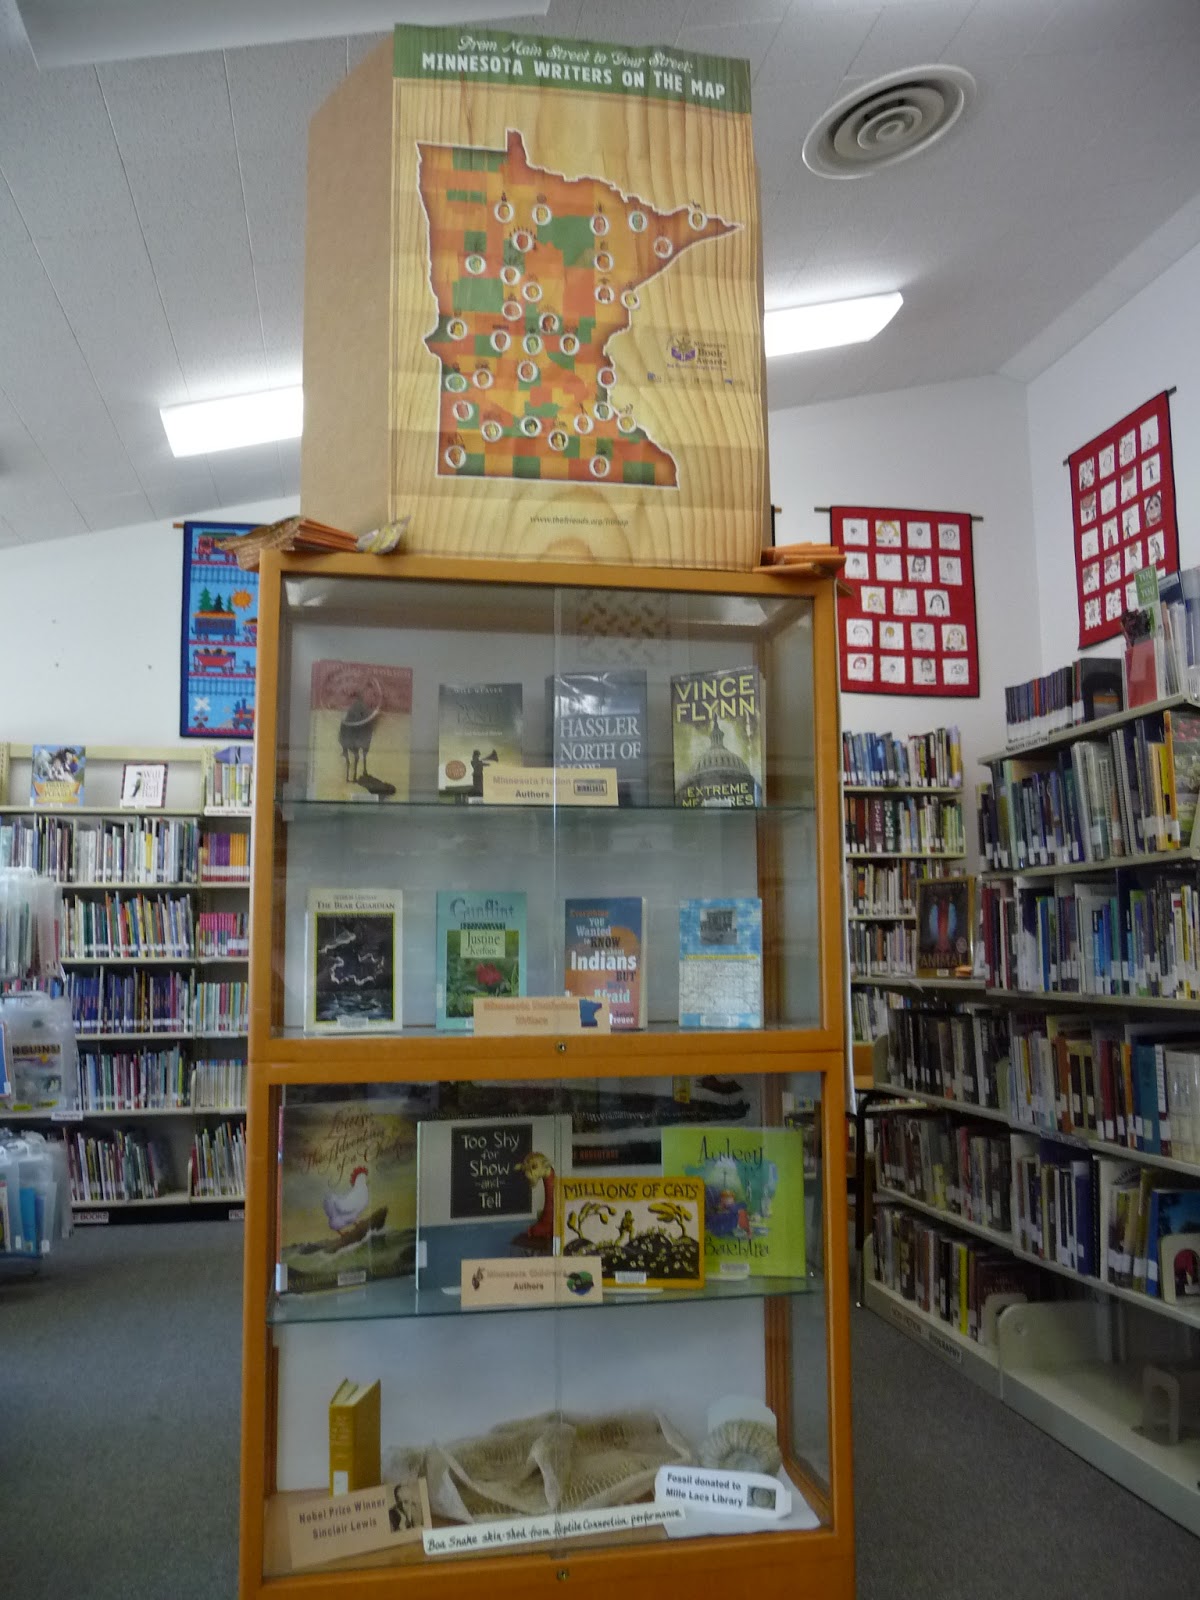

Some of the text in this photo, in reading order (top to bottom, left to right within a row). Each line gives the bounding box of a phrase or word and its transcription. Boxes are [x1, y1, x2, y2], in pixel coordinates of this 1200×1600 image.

[458, 35, 497, 51] From
[502, 40, 542, 56] Main
[547, 45, 589, 62] Street
[593, 51, 607, 64] to
[422, 52, 725, 100] MINNESOTA WRITERS ON THE MAP
[676, 675, 754, 701] VINCE
[676, 698, 755, 723] FLYNN
[560, 716, 641, 738] HASSLER
[560, 741, 642, 761] NORTH OF
[515, 789, 550, 799] Authors
[687, 782, 749, 798] EXTREME
[576, 924, 612, 937] Wanted
[588, 917, 605, 927] YOU
[466, 930, 501, 950] Justine
[590, 936, 621, 948] KNOW
[571, 950, 637, 971] Indians
[616, 971, 637, 982] BUT
[460, 1131, 520, 1152] Too Shy
[470, 1160, 510, 1178] Show
[479, 1192, 502, 1209] Tell
[563, 1181, 699, 1200] MILLIONS OF CATS
[513, 1281, 544, 1291] Authors
[667, 1472, 742, 1490] Fossil donated to
[666, 1487, 743, 1508] Mille Lacs Library
[299, 1499, 386, 1524] Nobel Prize Winner
[313, 1516, 377, 1539] Sinclair Lewis
[427, 1537, 446, 1551] Boa
[449, 1534, 478, 1547] Snake
[529, 1524, 552, 1538] from
[583, 1517, 628, 1530] Connection
